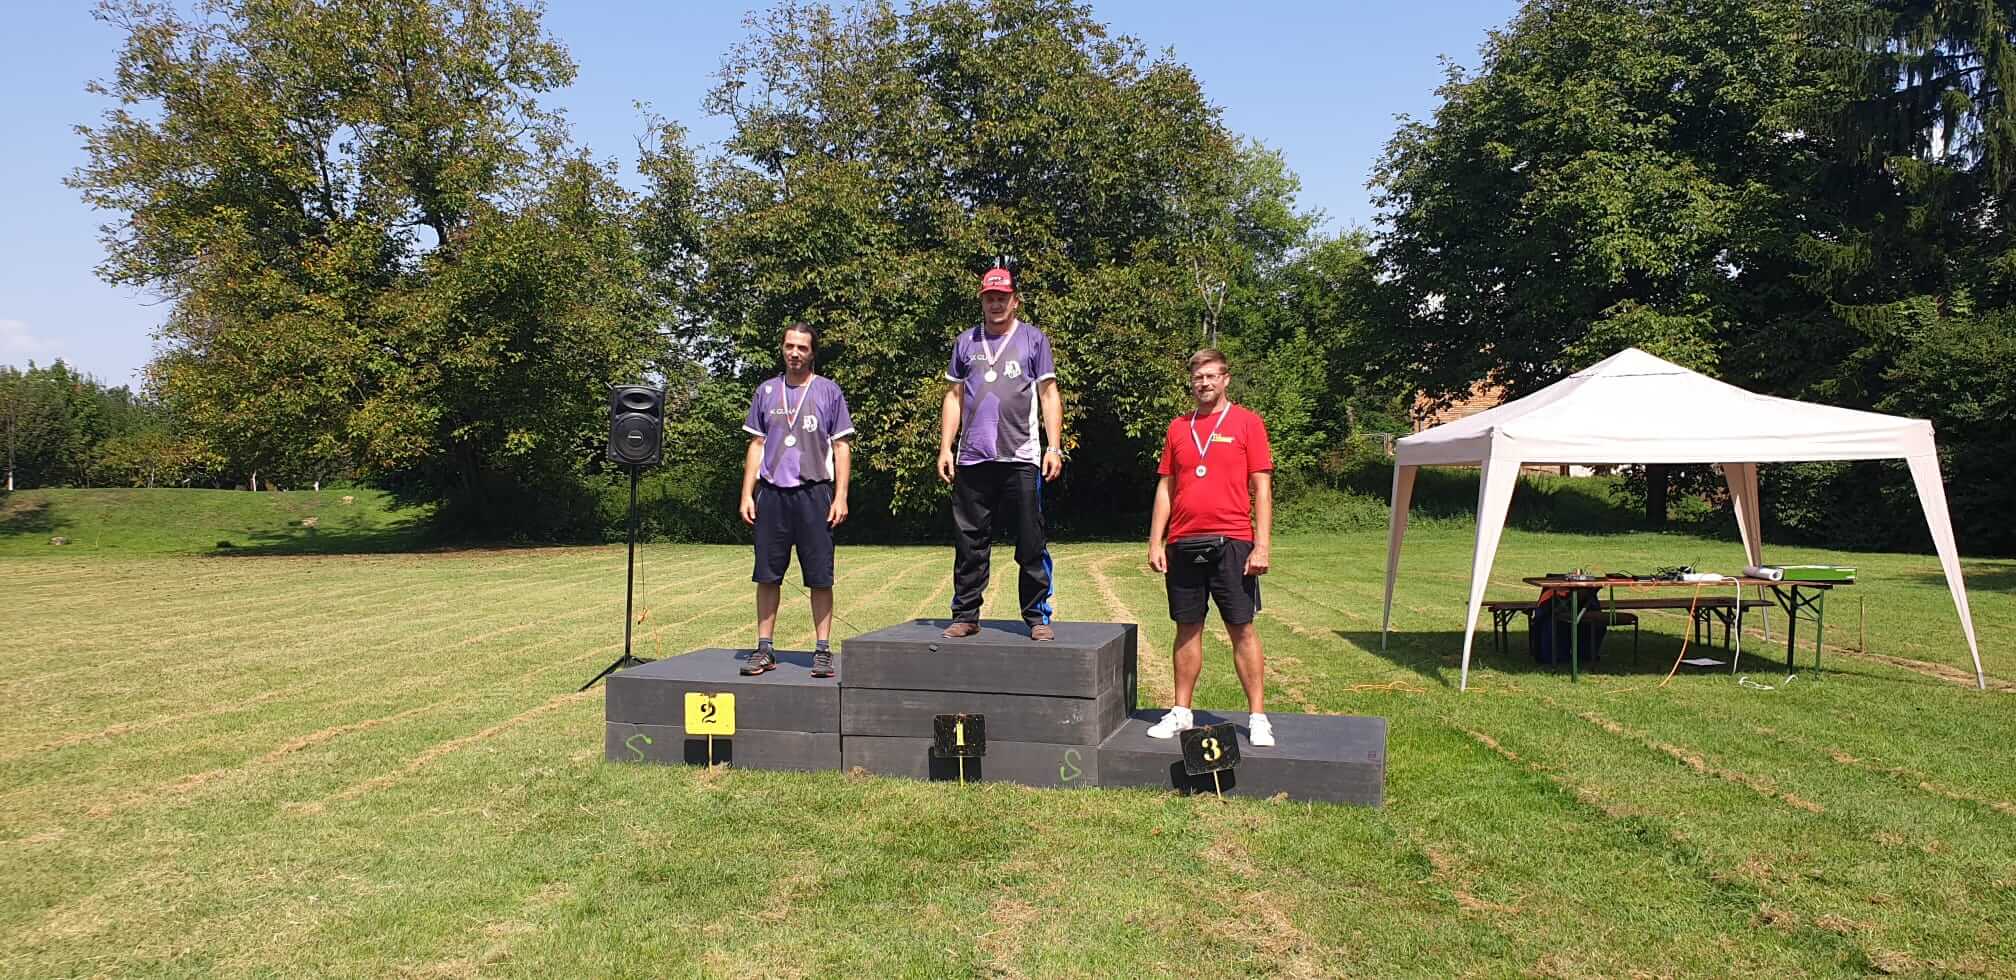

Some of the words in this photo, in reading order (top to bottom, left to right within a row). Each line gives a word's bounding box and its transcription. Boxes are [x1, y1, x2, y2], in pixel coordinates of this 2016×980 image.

[700, 703, 717, 724] 2
[955, 720, 966, 746] 1
[1201, 737, 1221, 761] 3
